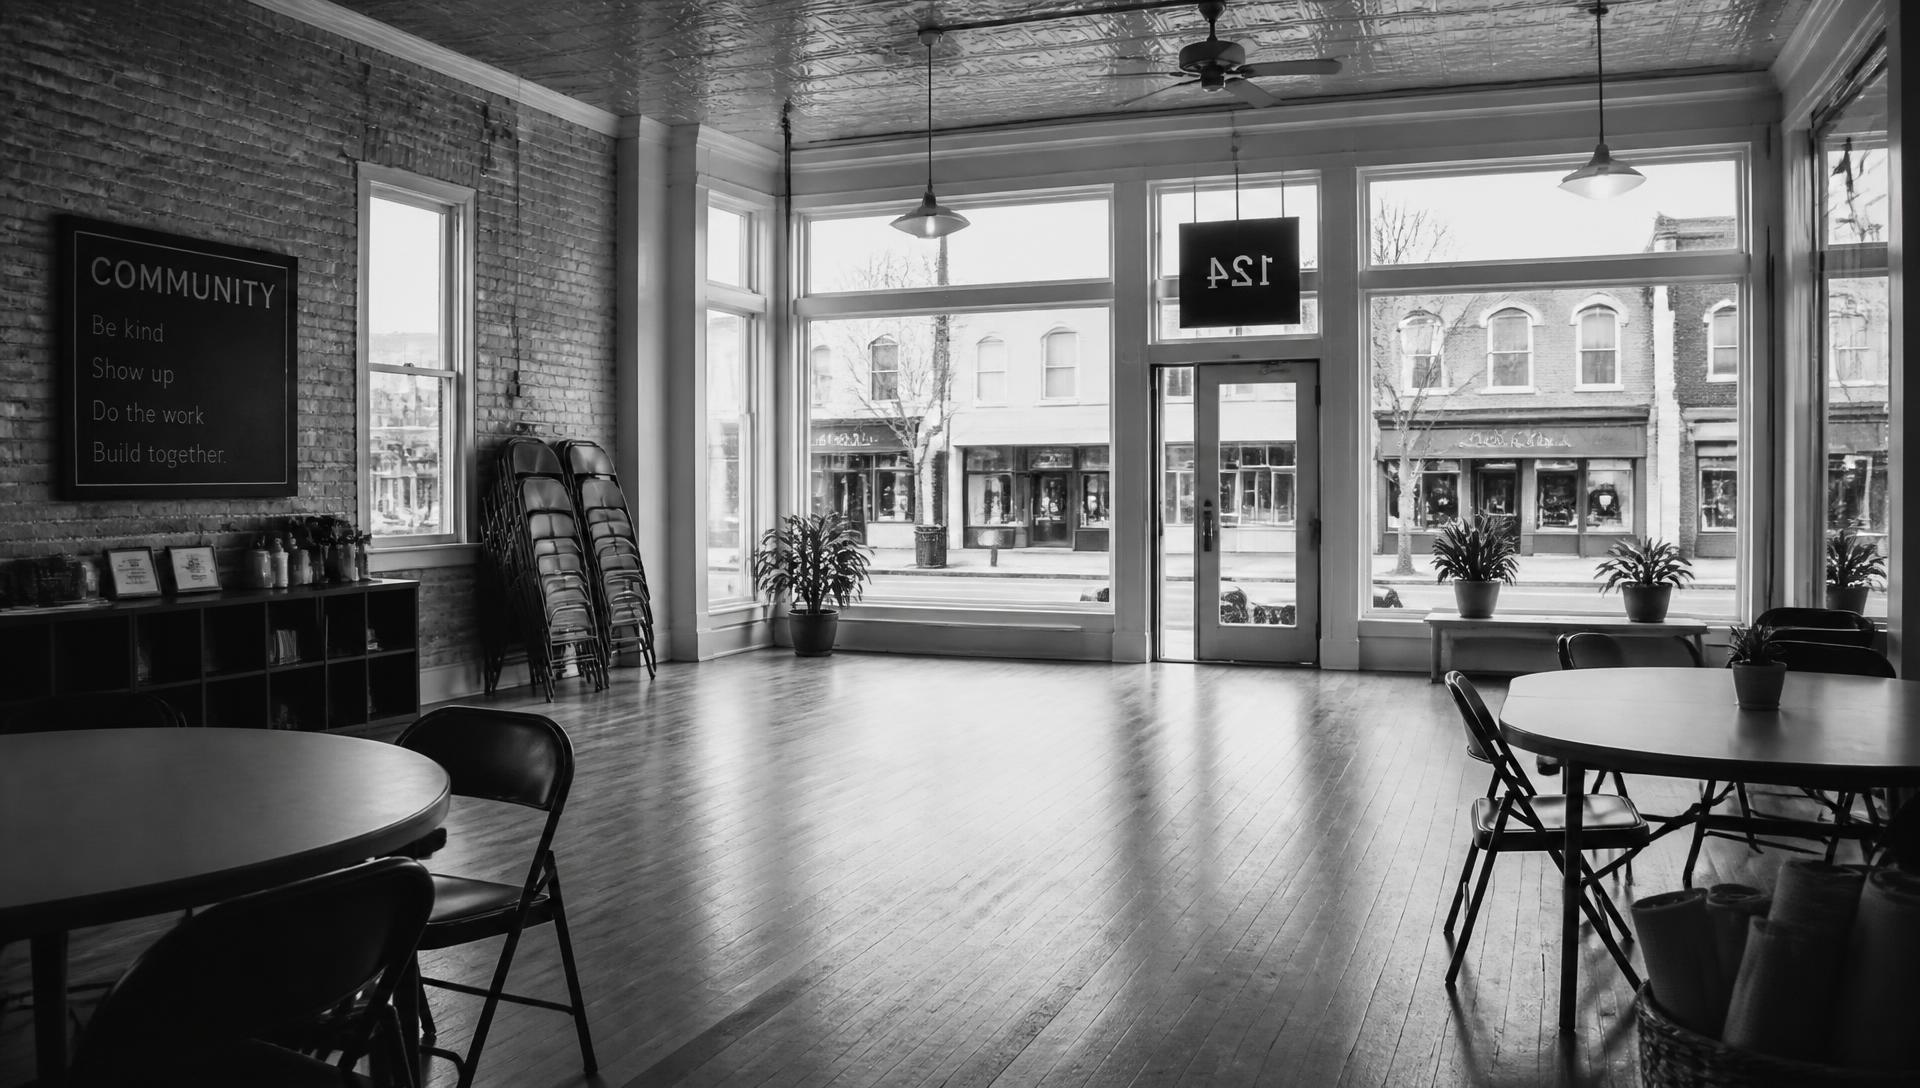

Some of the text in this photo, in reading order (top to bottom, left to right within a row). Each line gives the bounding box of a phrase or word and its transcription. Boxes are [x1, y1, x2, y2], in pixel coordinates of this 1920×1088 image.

[91, 256, 276, 309] COMMUNITY
[92, 313, 164, 343] Be kind
[92, 356, 175, 389] Show up
[93, 400, 205, 425] Do the work
[93, 441, 227, 469] Build together.
